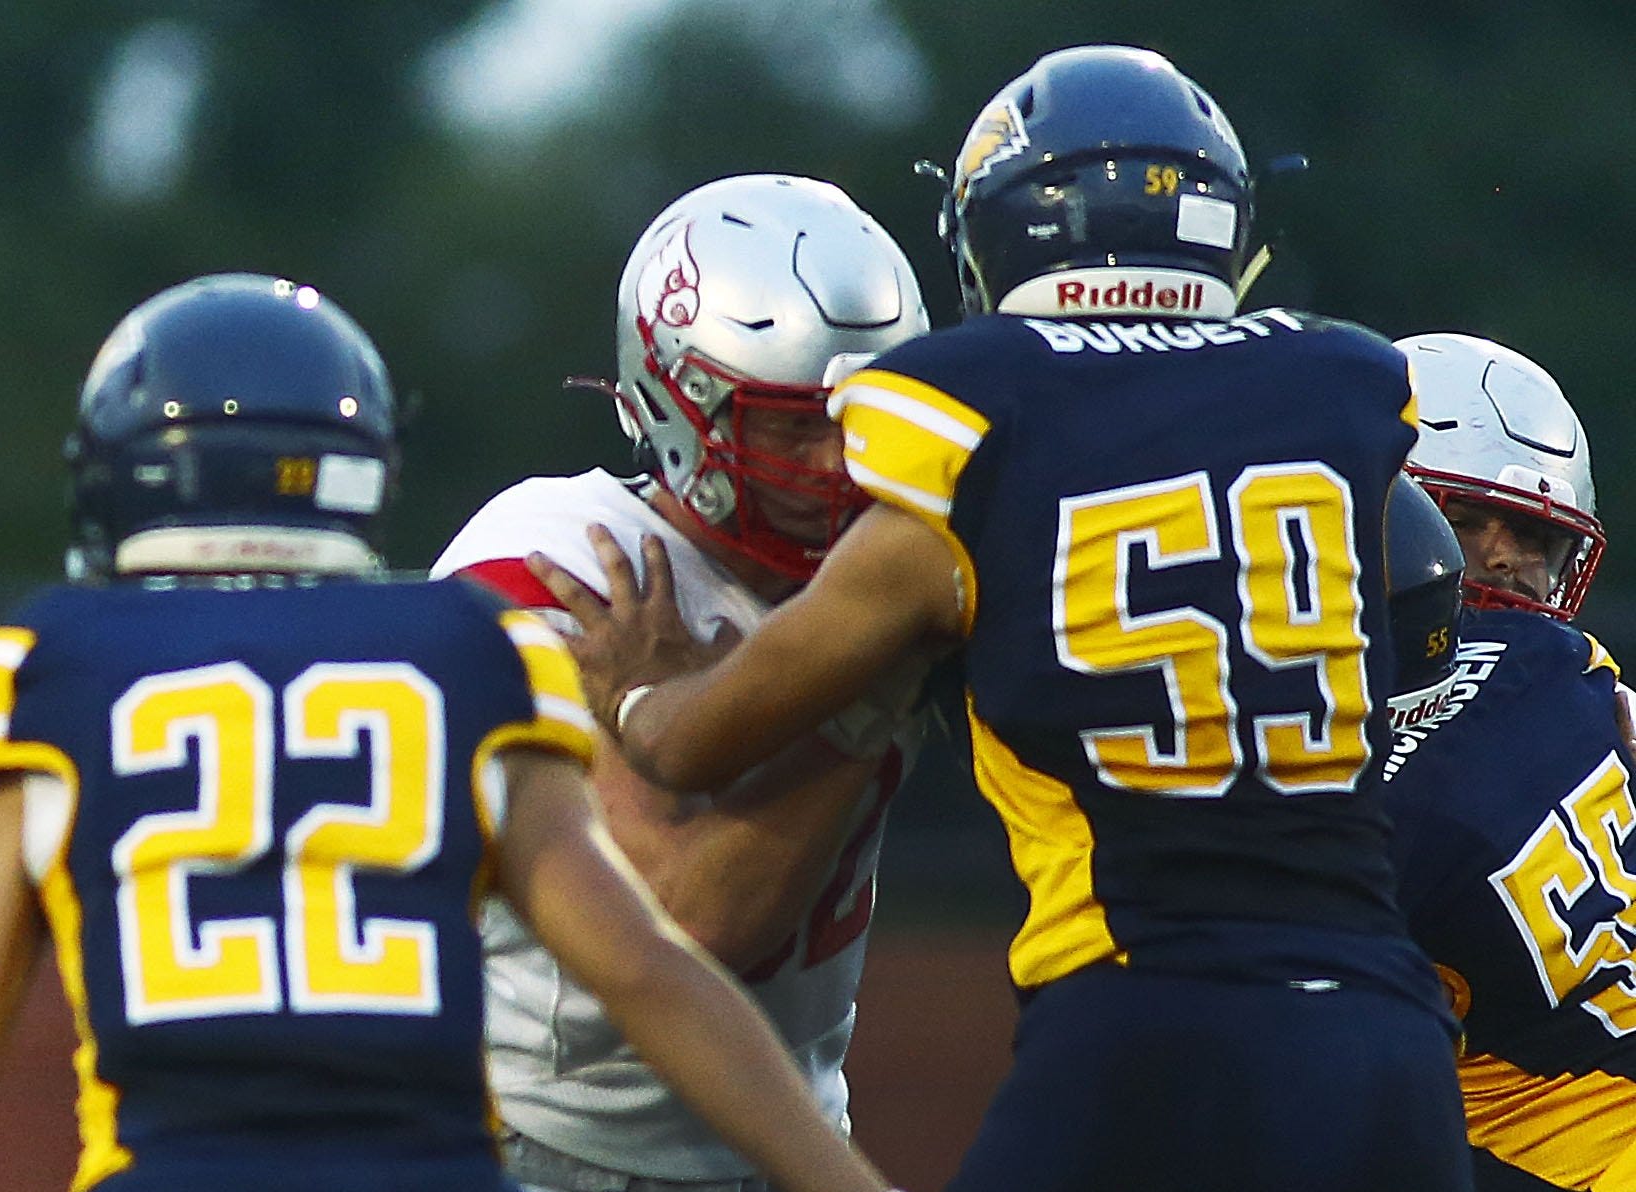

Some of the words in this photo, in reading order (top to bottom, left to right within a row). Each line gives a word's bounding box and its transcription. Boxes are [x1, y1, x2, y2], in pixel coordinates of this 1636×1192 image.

[1144, 163, 1179, 196] 59
[1057, 279, 1205, 312] Riddell
[1052, 460, 1372, 799] 59
[1425, 626, 1450, 658] 55
[110, 660, 448, 1026] 22
